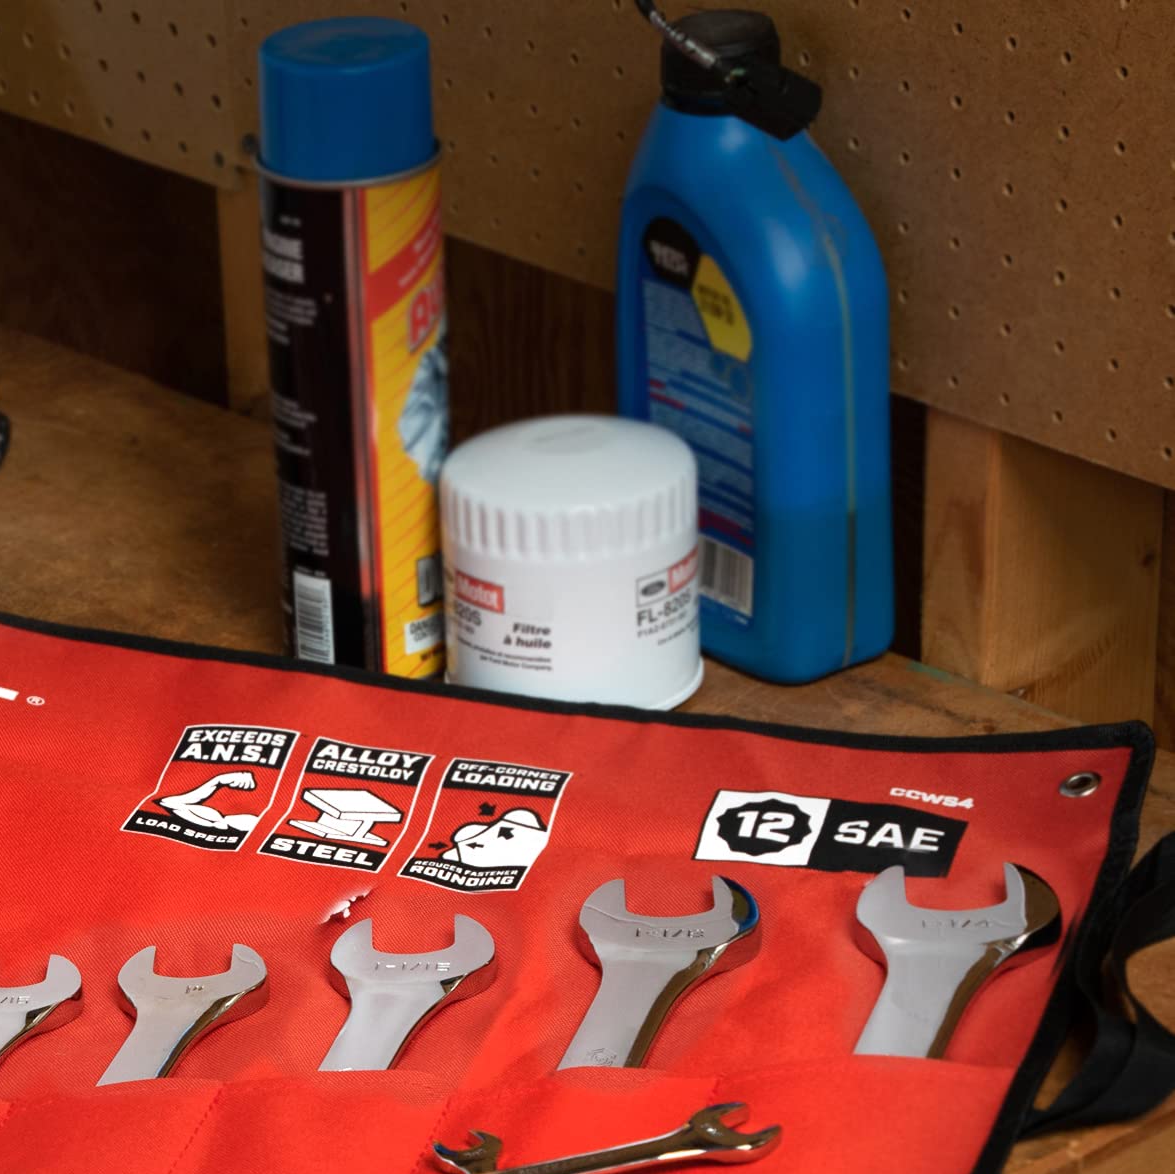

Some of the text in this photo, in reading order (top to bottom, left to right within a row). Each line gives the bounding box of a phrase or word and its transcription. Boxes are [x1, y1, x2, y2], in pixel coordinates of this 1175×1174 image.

[512, 622, 552, 636] Filtre
[515, 636, 553, 649] huile
[187, 729, 287, 747] EXCEEDS
[316, 744, 424, 769] ALLOY
[312, 759, 415, 781] CRESTOLOY
[457, 762, 561, 781] OFF-CORNER
[451, 771, 557, 792] LOADING
[135, 817, 239, 843] LOAD SPECS
[737, 810, 944, 851] 12 SAE
[270, 837, 374, 866] STEEL
[409, 865, 515, 887] ROUNDING
[414, 860, 518, 877] REDUCES FASTENER
